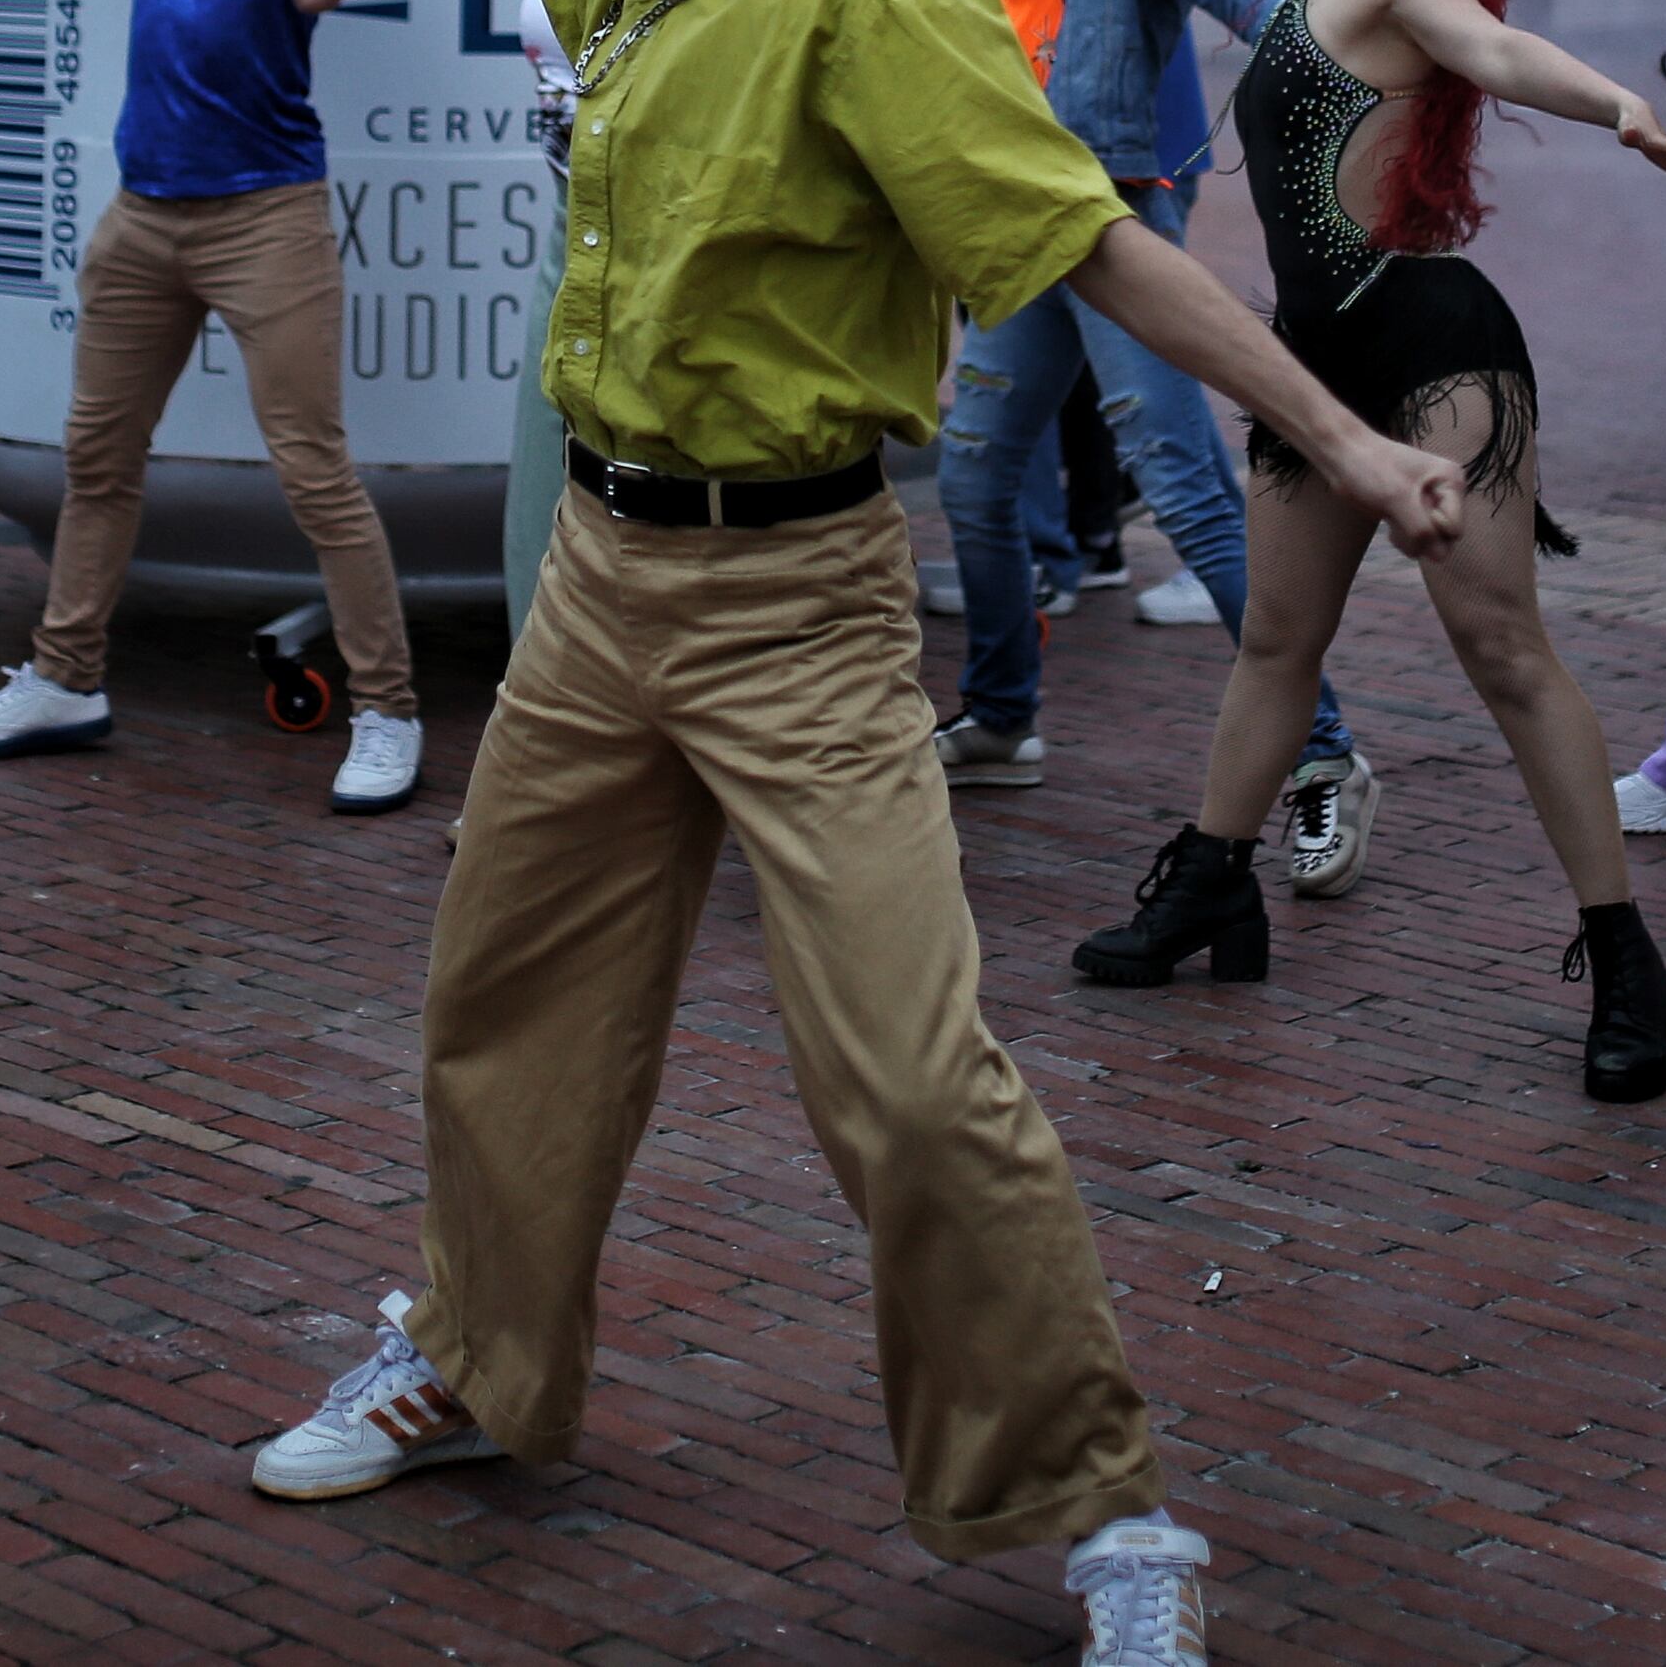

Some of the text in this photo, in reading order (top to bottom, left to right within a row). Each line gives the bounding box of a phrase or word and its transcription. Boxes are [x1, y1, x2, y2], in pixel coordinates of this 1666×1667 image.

[365, 107, 545, 145] CERVE
[51, 138, 79, 272] 20809
[336, 179, 539, 271] XCES
[50, 308, 77, 334] 3
